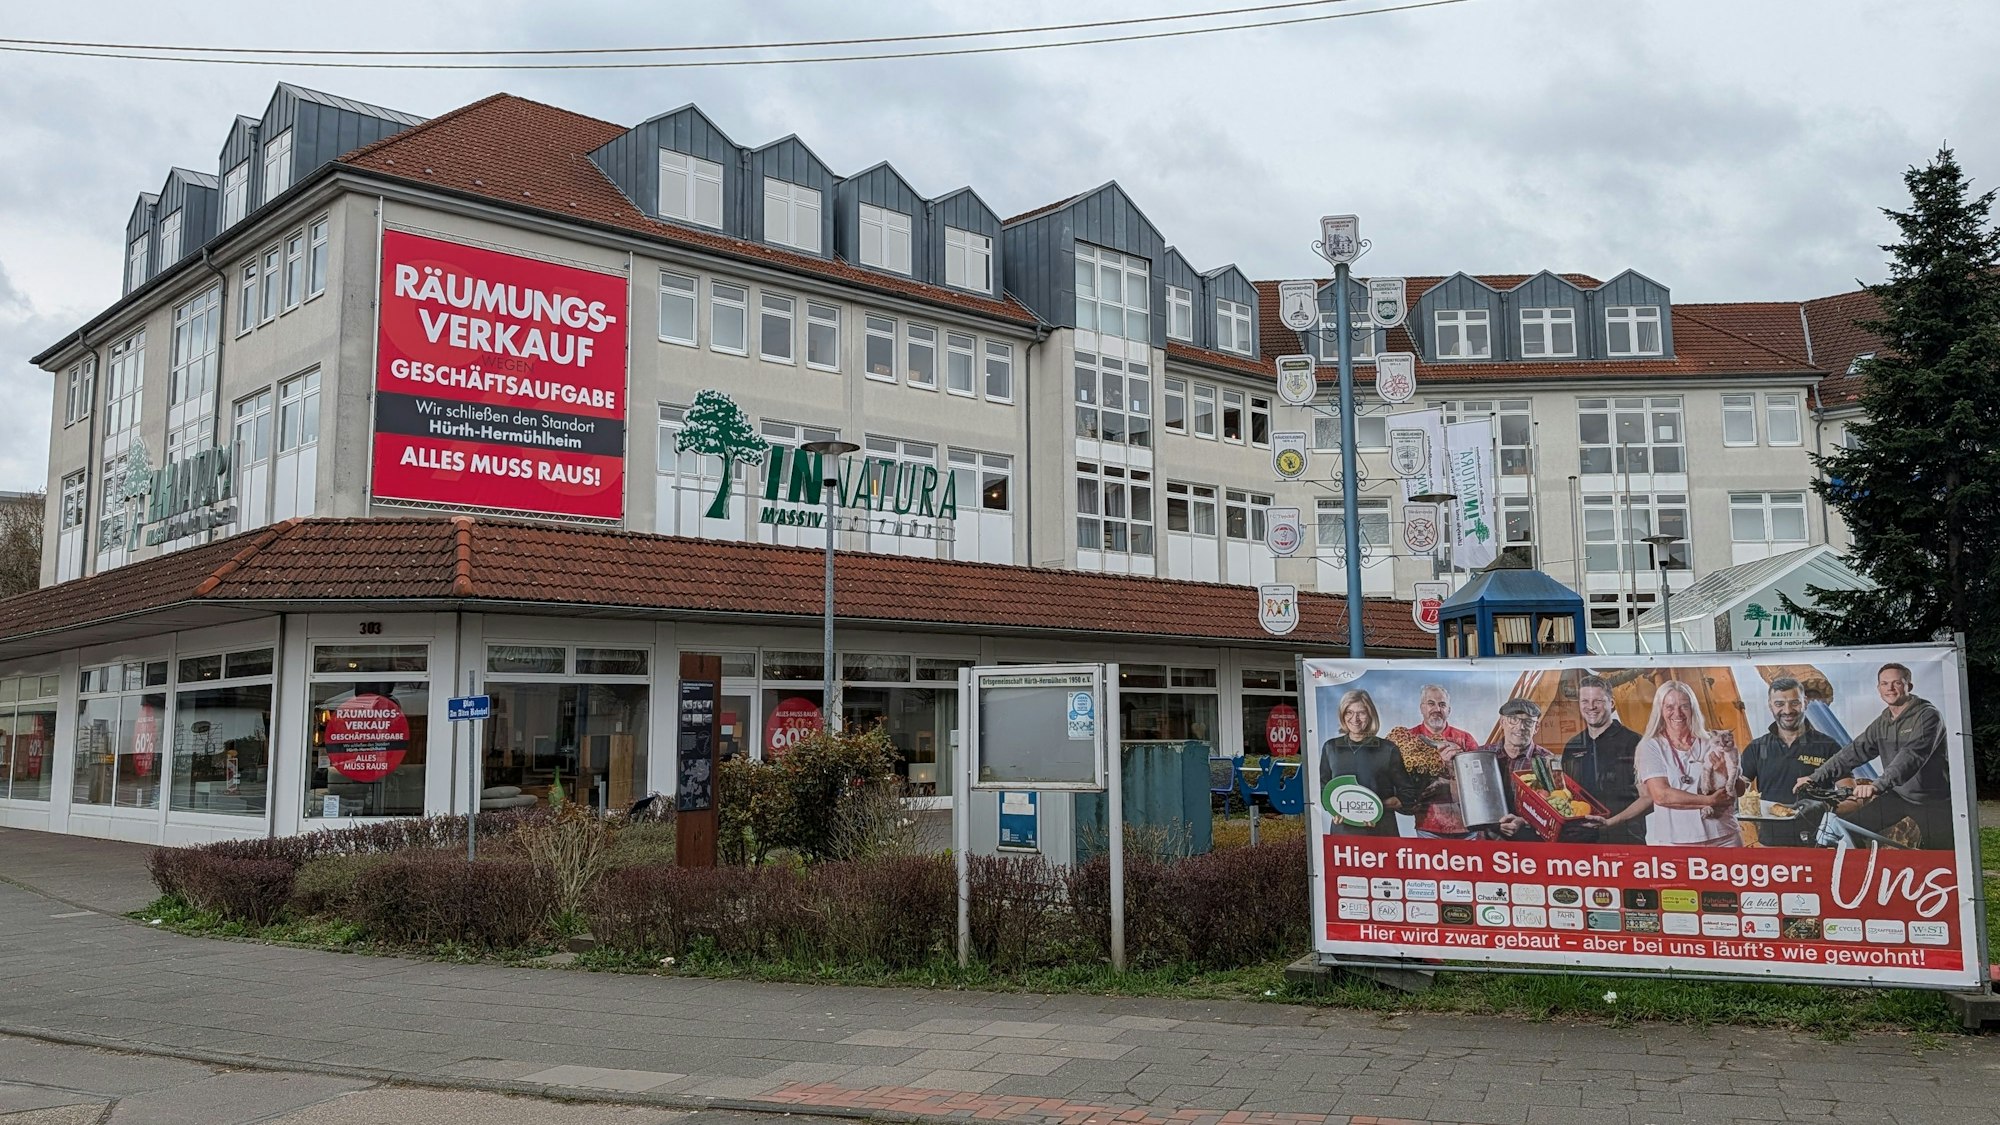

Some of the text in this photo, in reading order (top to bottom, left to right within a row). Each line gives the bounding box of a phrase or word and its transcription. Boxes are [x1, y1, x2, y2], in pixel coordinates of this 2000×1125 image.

[395, 263, 616, 332] RÄUMUNGS-
[418, 308, 594, 368] VERKAUF
[482, 354, 535, 373] WEGEN
[391, 358, 615, 409] GESCHÄFTSAUFGABE
[416, 400, 595, 433] Wir schließen den Standort
[429, 420, 582, 449] Hürth-Hermühlheim
[400, 446, 601, 486] ALLES MUSS RAUS!
[763, 445, 957, 520] INNATURA
[760, 506, 823, 528] MASSIV
[359, 622, 382, 634] 303
[983, 678, 1023, 686] Ortsgemeinschaft
[336, 709, 400, 718] RÄUMUNGS-
[345, 721, 391, 730] VERKAUF
[1270, 727, 1298, 742] 60%
[136, 733, 154, 753] 60%
[331, 732, 404, 741] GESCHÄFTSAUFGABE
[1339, 801, 1374, 813] HOSPIZ
[1333, 839, 1958, 918] Hier finden Sie mehr als Bagger: Uns
[1757, 898, 1778, 907] belle
[1360, 924, 1395, 942] Hier
[1401, 927, 1439, 944] wird
[1445, 933, 1488, 946] zwar
[1495, 931, 1560, 949] gebaut
[1583, 936, 1627, 951] aber
[1633, 937, 1662, 954] bei
[1670, 942, 1706, 955] uns
[1782, 946, 1818, 960] wie
[1824, 947, 1926, 966] gewohnt!
